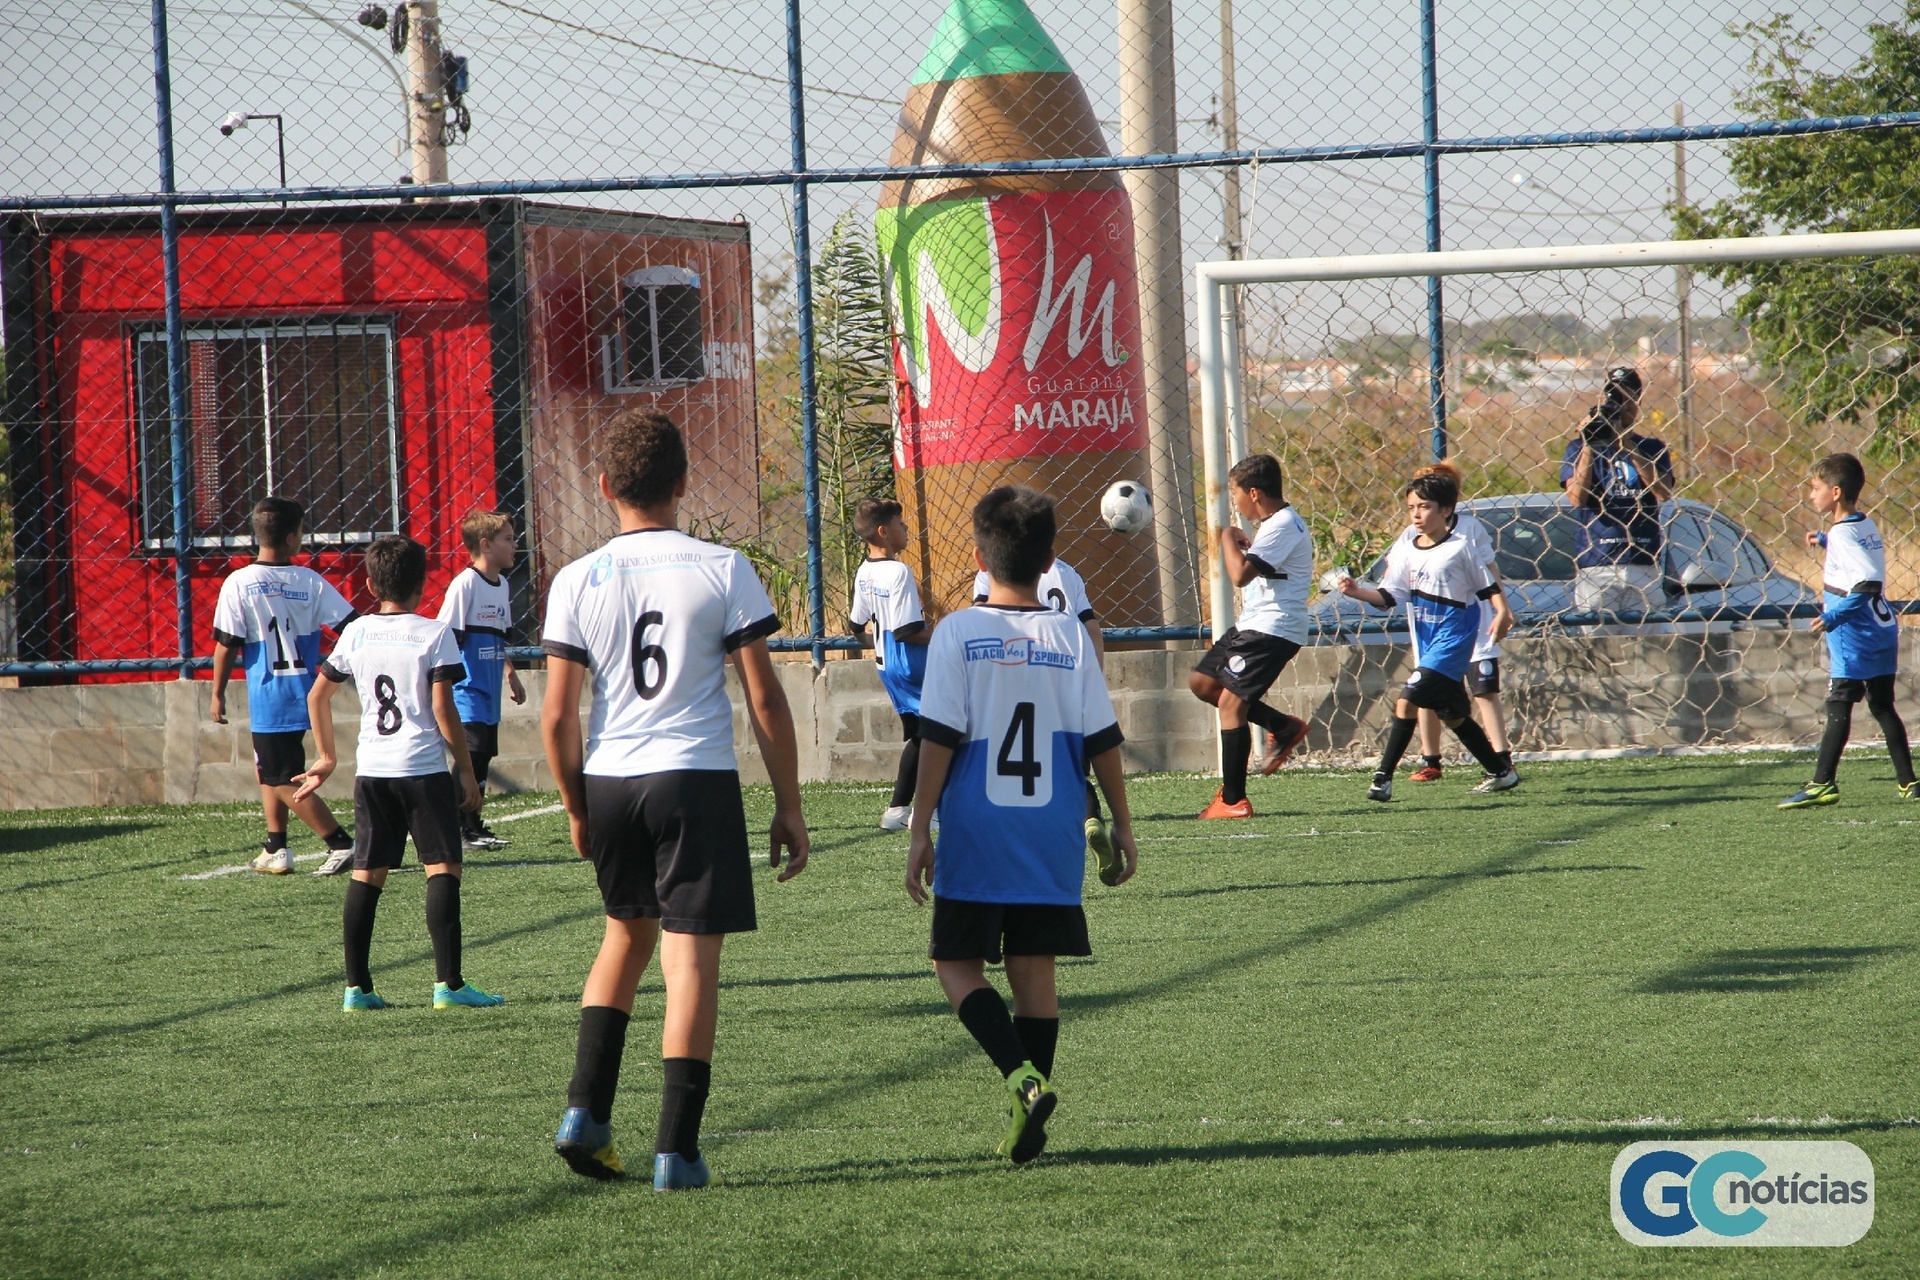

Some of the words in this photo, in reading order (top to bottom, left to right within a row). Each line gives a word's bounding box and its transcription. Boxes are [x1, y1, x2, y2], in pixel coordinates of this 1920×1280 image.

[1027, 374, 1124, 394] Guaraná
[1014, 391, 1134, 433] MARAJÁ
[668, 552, 702, 563] CAMILO
[632, 610, 668, 701] 6
[965, 637, 1005, 662] PALACIO
[1006, 644, 1025, 658] dos
[1027, 640, 1077, 670] ESPORTES
[374, 674, 403, 736] 8
[997, 701, 1042, 797] 4
